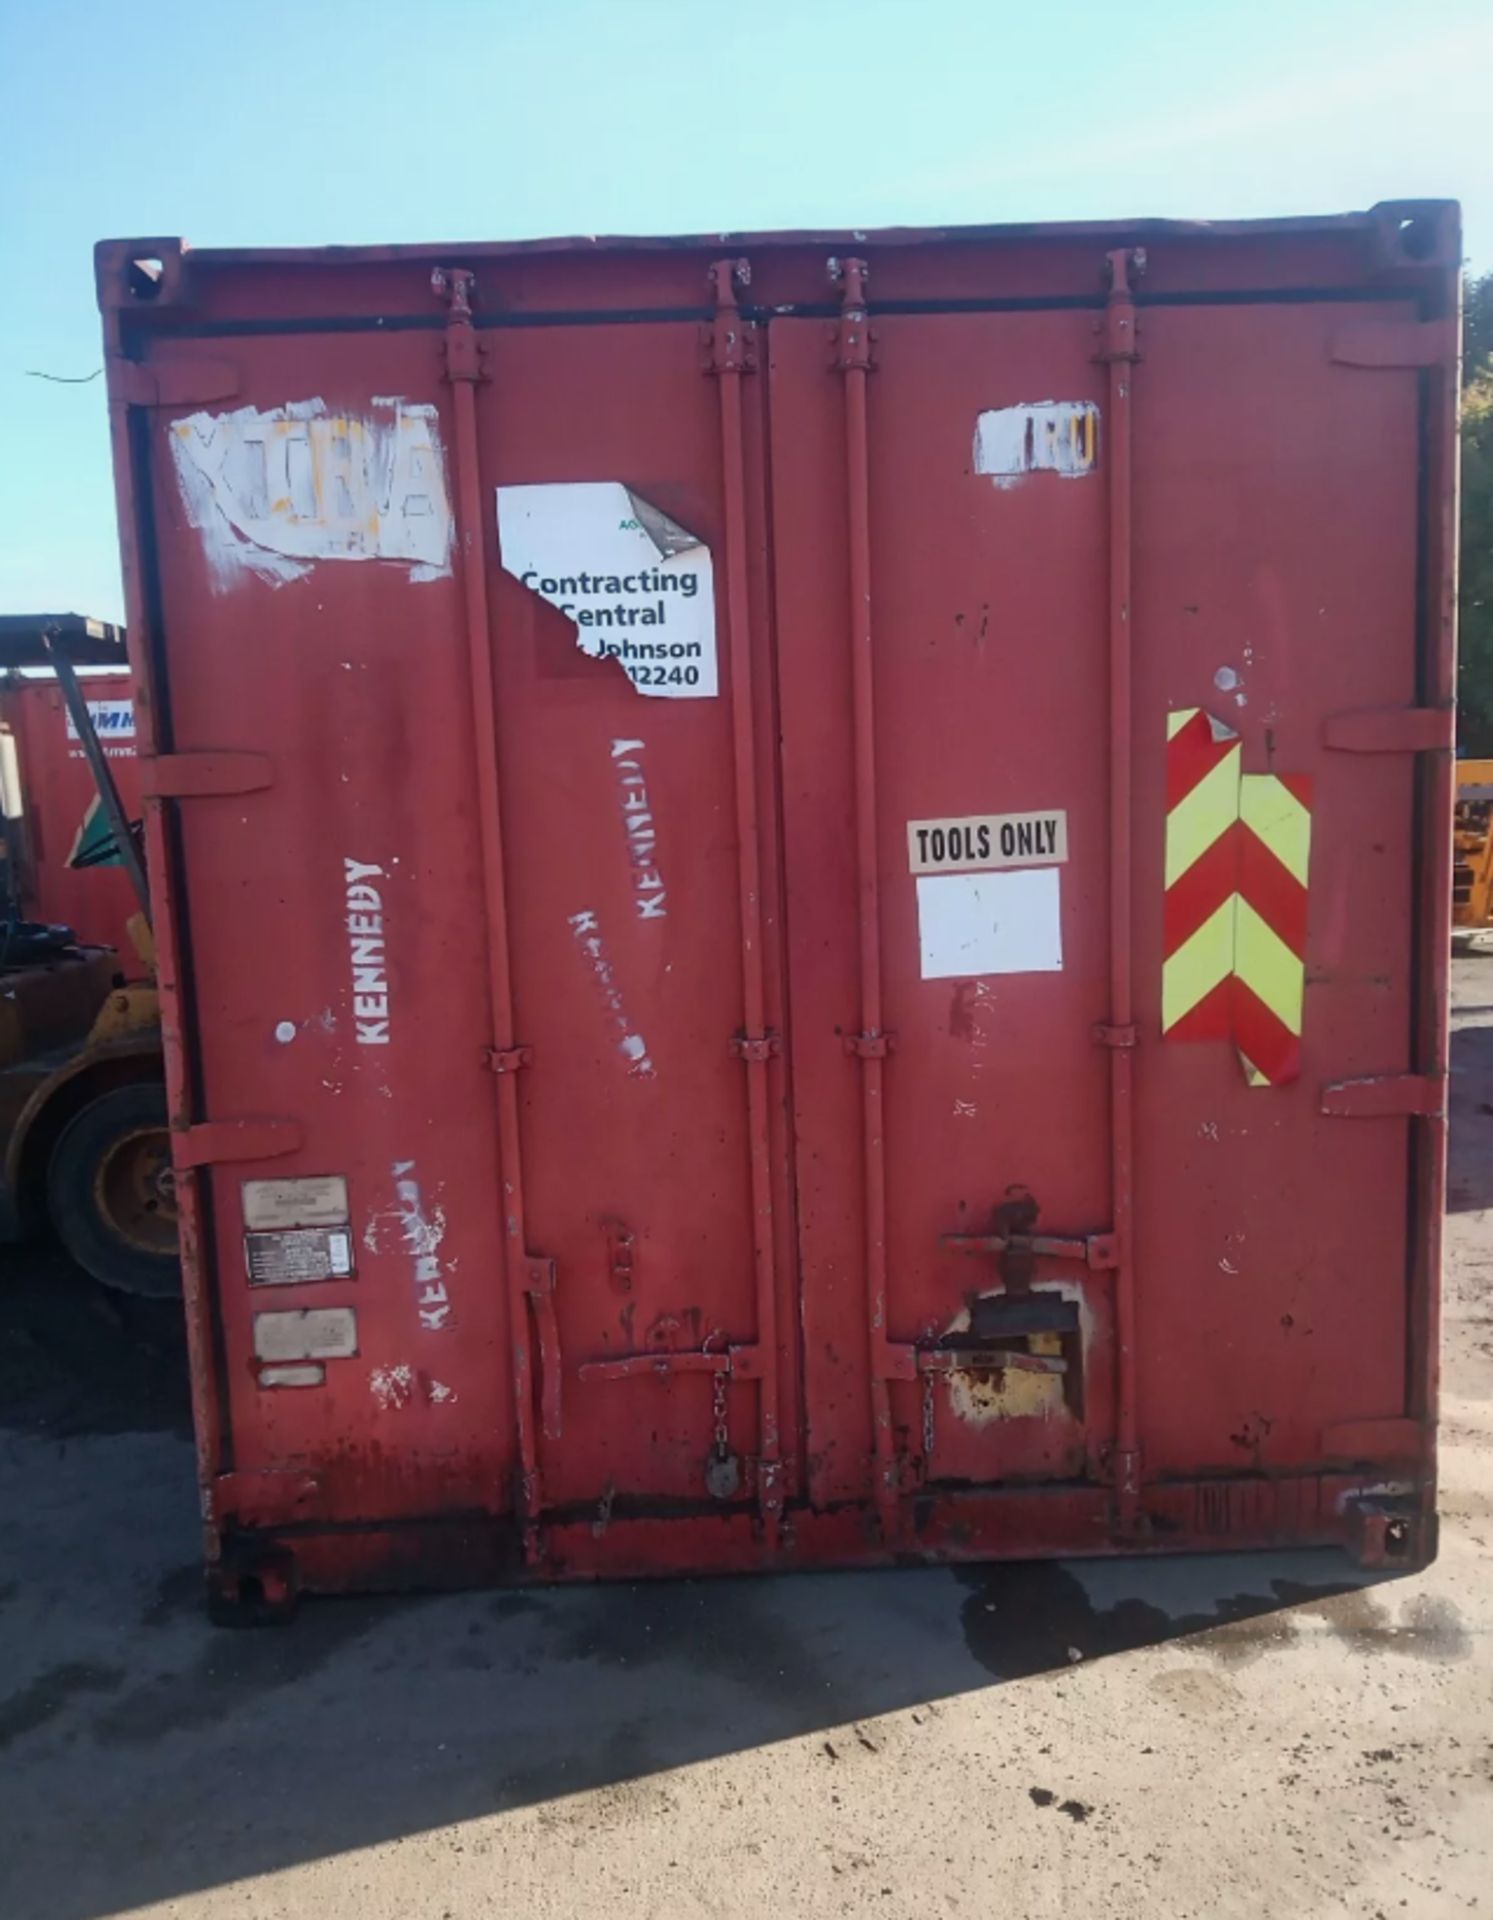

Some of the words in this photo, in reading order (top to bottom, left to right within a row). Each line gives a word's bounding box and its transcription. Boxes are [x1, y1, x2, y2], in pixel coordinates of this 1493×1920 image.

[521, 567, 698, 597] Contracting
[597, 638, 702, 659] Johnson
[611, 739, 667, 918] KENNEDY
[916, 825, 990, 863] TOOLS
[1000, 820, 1056, 857] ONLY
[344, 857, 390, 1044] KENNEDY
